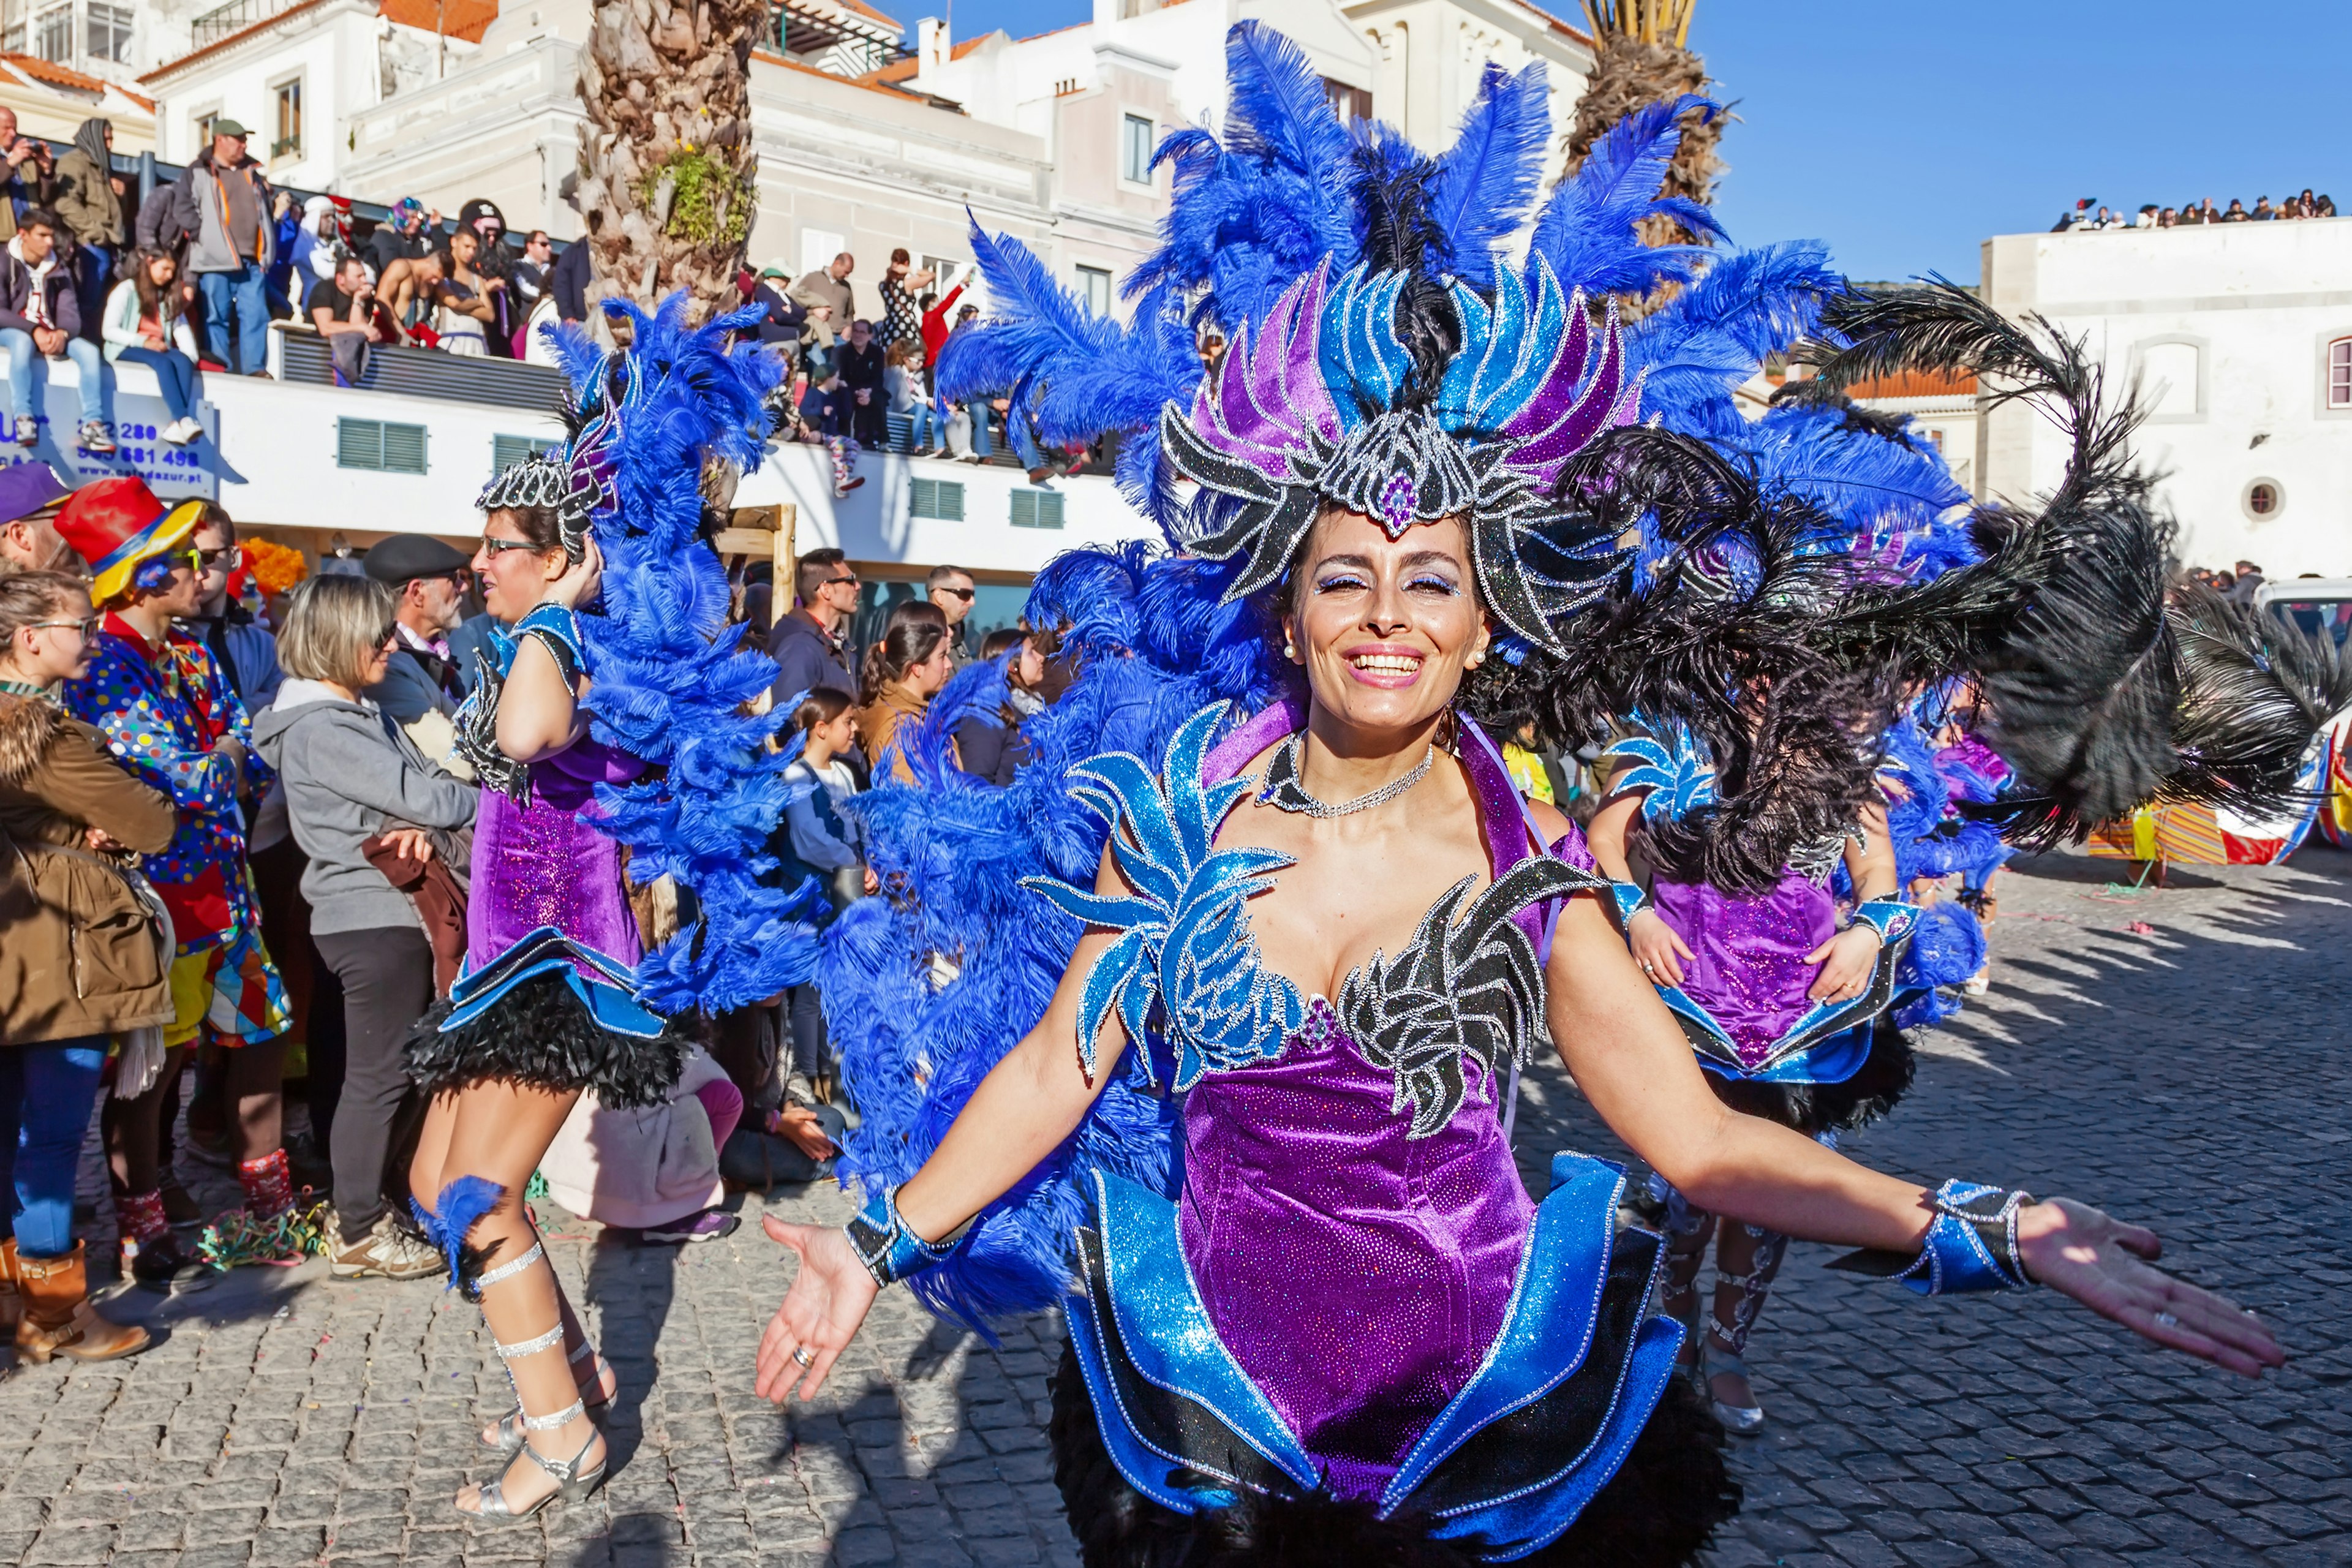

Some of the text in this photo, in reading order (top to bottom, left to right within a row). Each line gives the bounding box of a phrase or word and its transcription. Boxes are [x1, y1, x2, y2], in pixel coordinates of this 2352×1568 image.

[121, 423, 157, 440] 280
[121, 447, 154, 464] 681
[162, 450, 199, 467] 498
